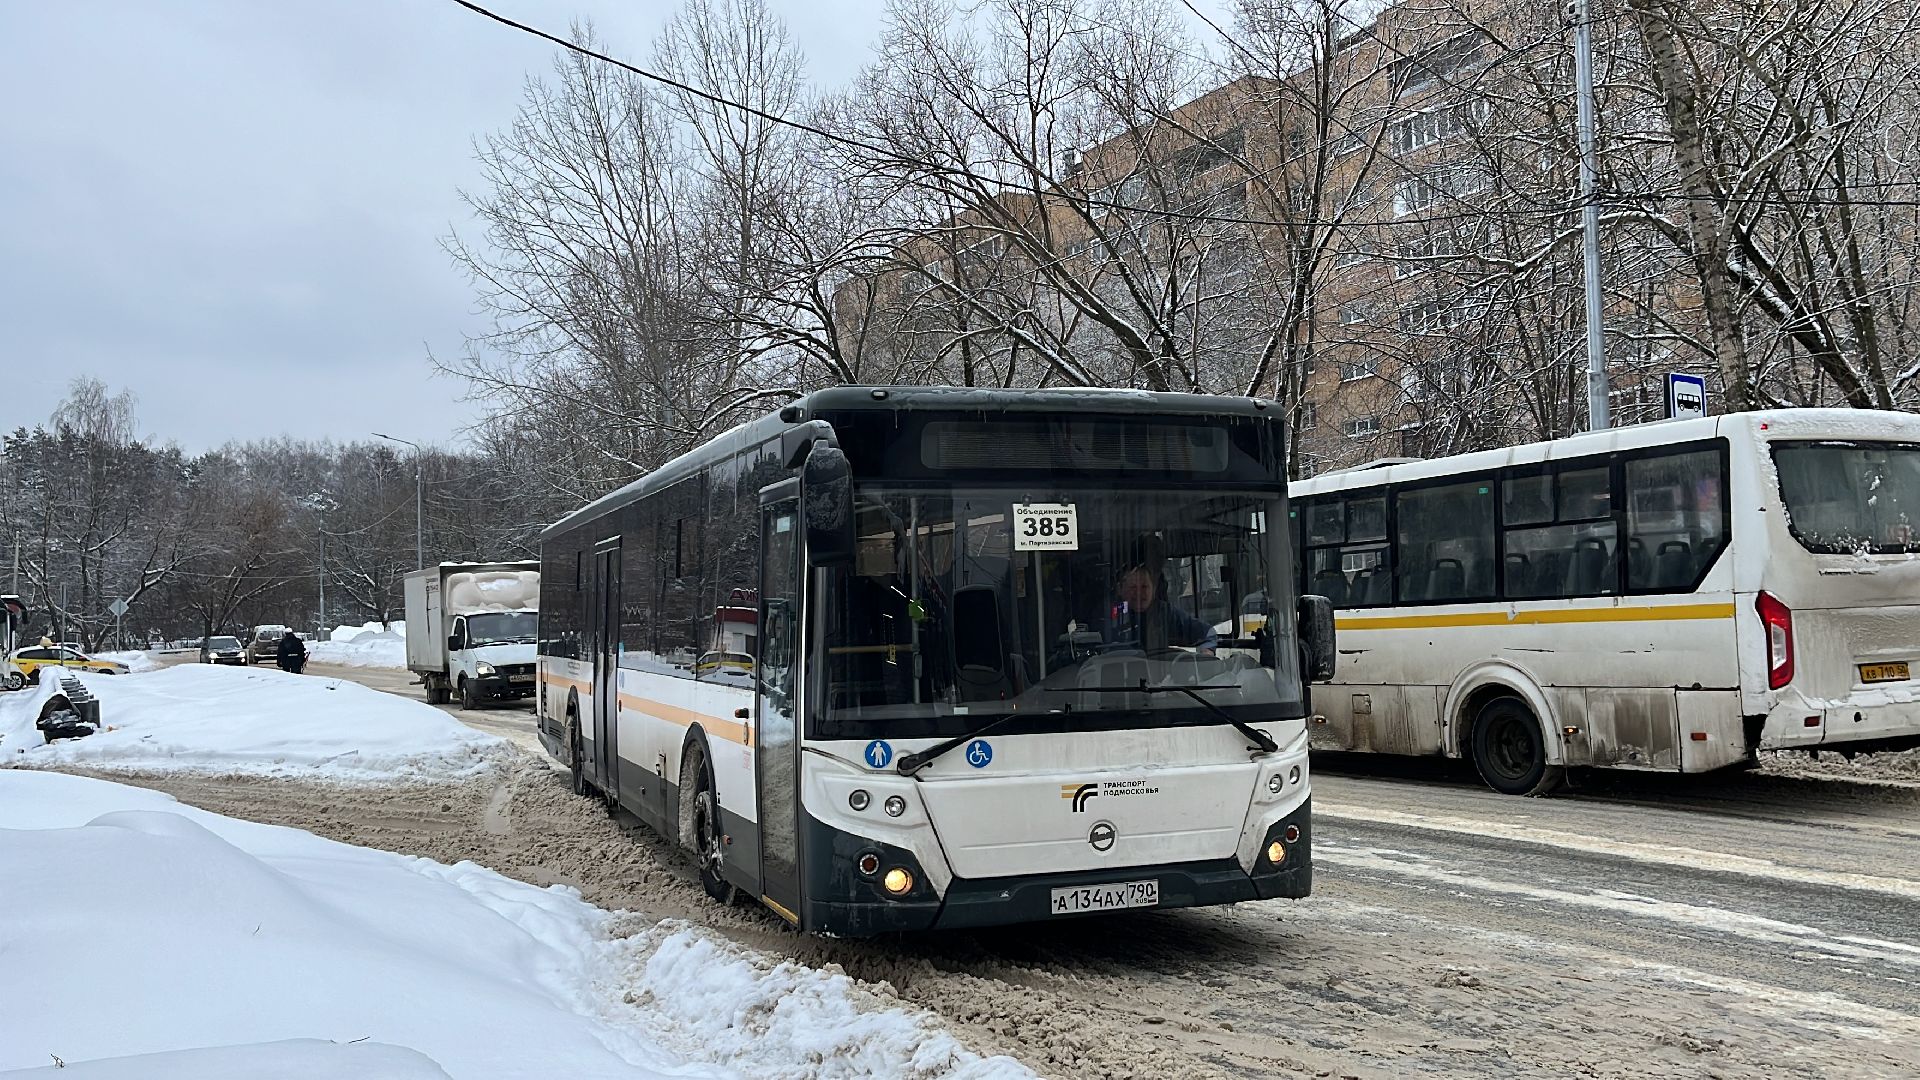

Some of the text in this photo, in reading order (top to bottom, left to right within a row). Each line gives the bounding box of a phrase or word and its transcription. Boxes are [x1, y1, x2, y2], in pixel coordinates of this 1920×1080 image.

[1023, 517, 1070, 537] 385
[1103, 780, 1147, 789] ТРАНСПОРТ
[1103, 787, 1159, 797] ПОДМОСКОВЬЯ
[1129, 882, 1155, 899] 790
